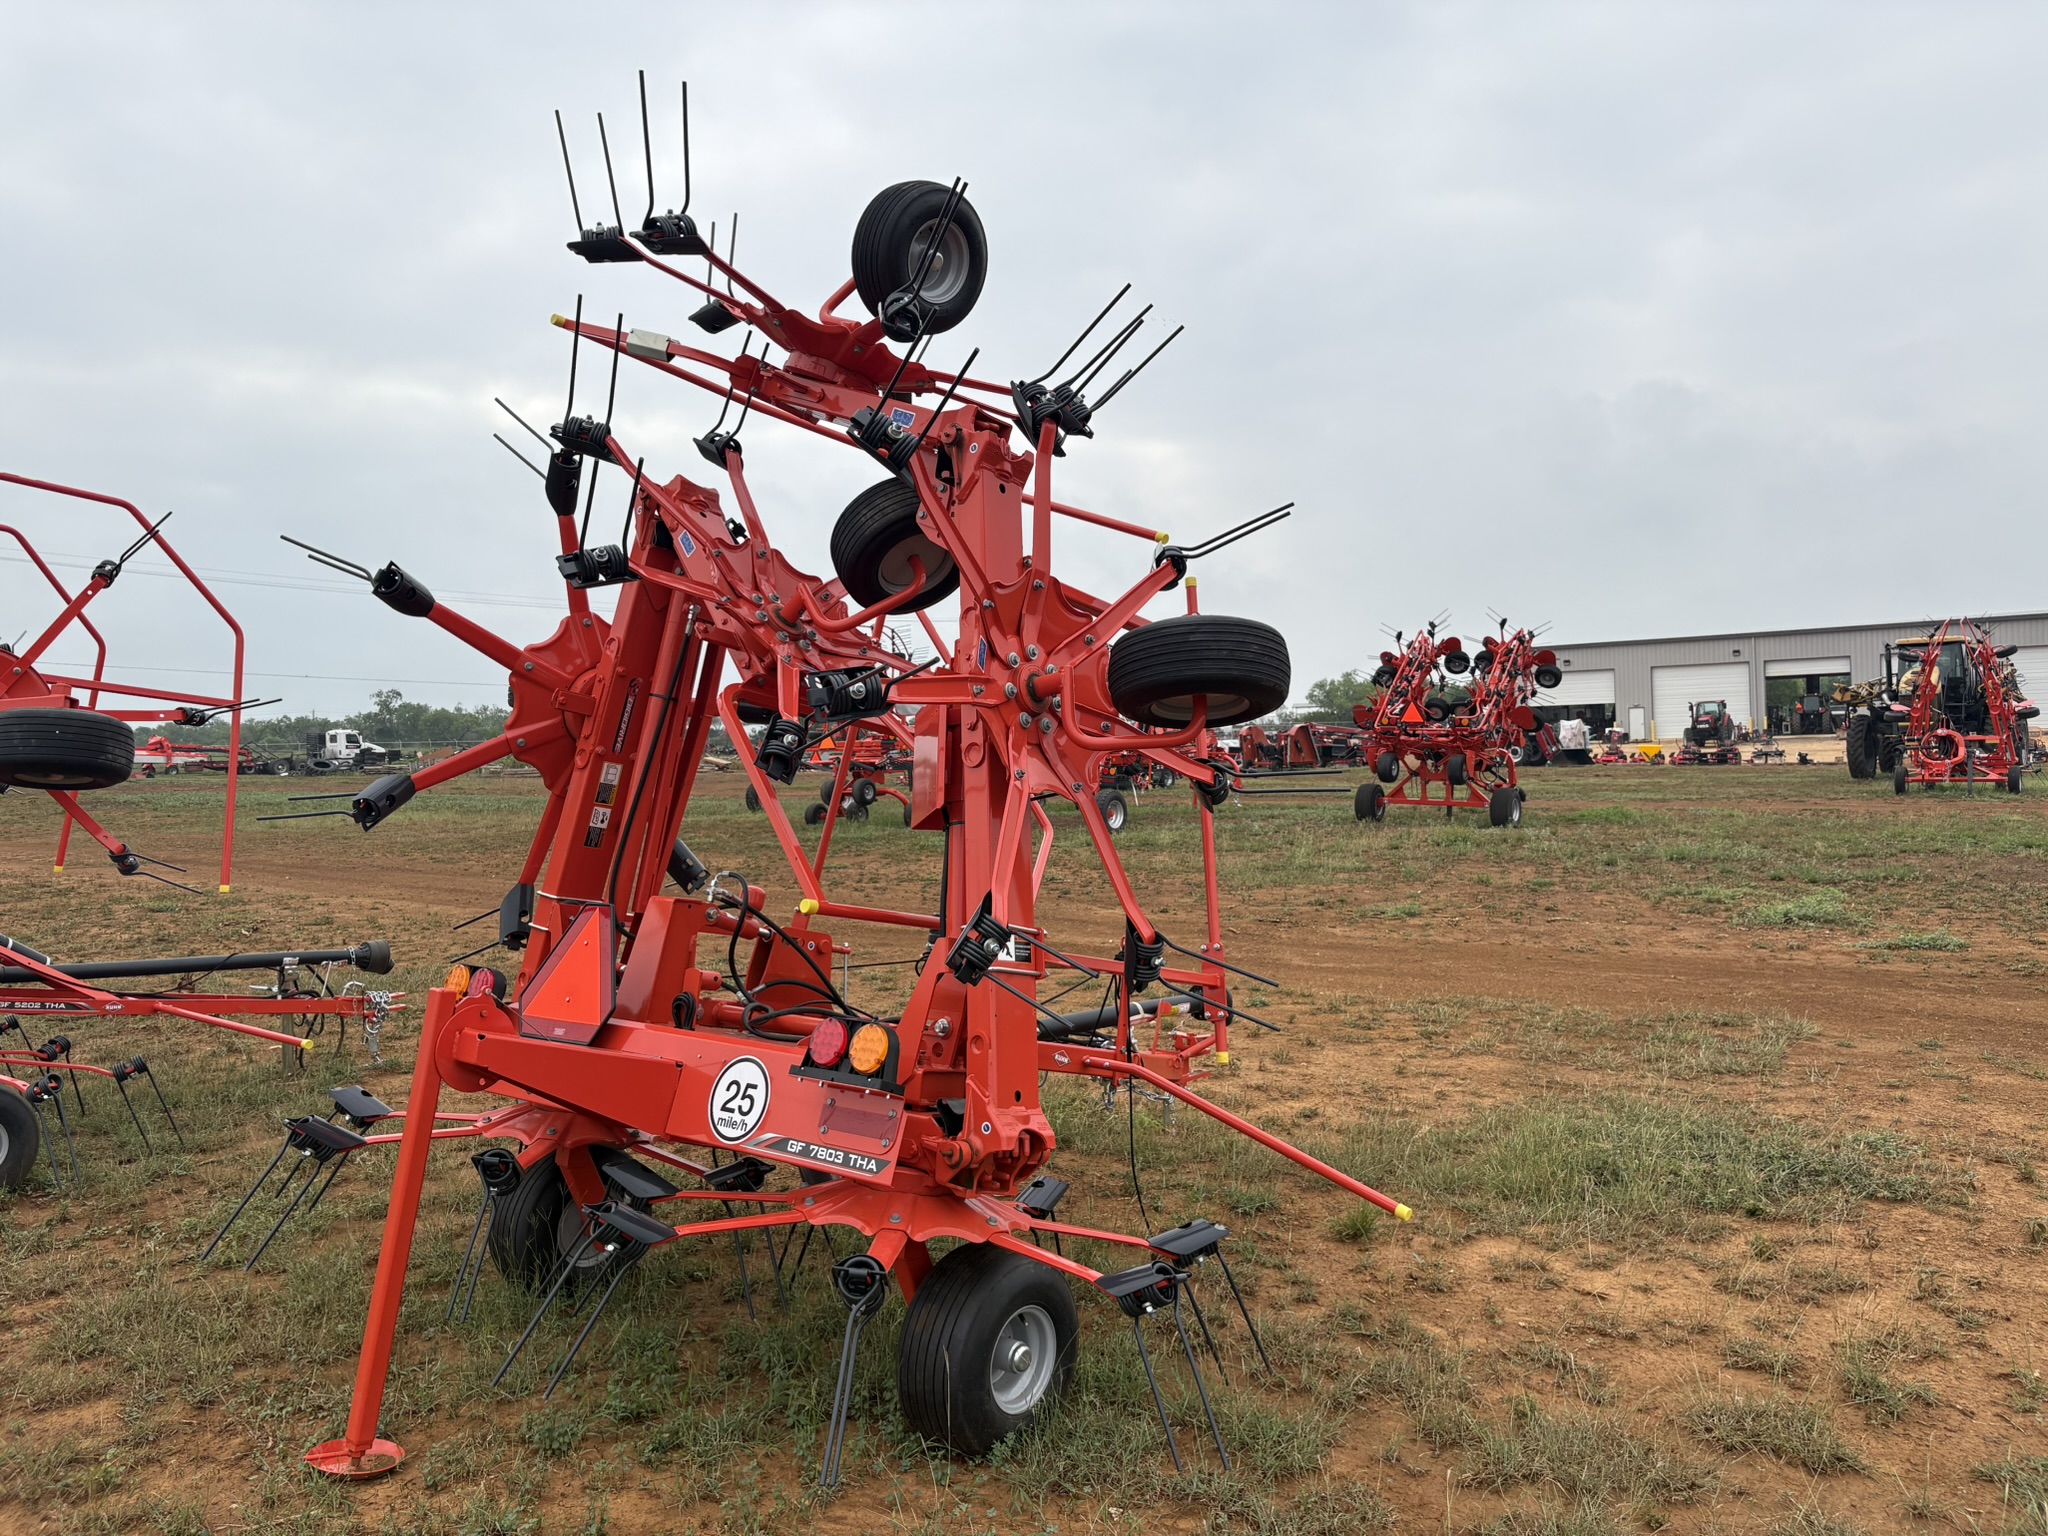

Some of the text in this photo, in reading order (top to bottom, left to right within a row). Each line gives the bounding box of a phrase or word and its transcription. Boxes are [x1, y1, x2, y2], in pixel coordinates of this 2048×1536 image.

[614, 695, 635, 754] DIGIDRIVE
[14, 1001, 41, 1009] 5202
[720, 1079, 759, 1117] 25
[716, 1115, 749, 1132] mile/h
[787, 1139, 877, 1172] GF 7803 THA
